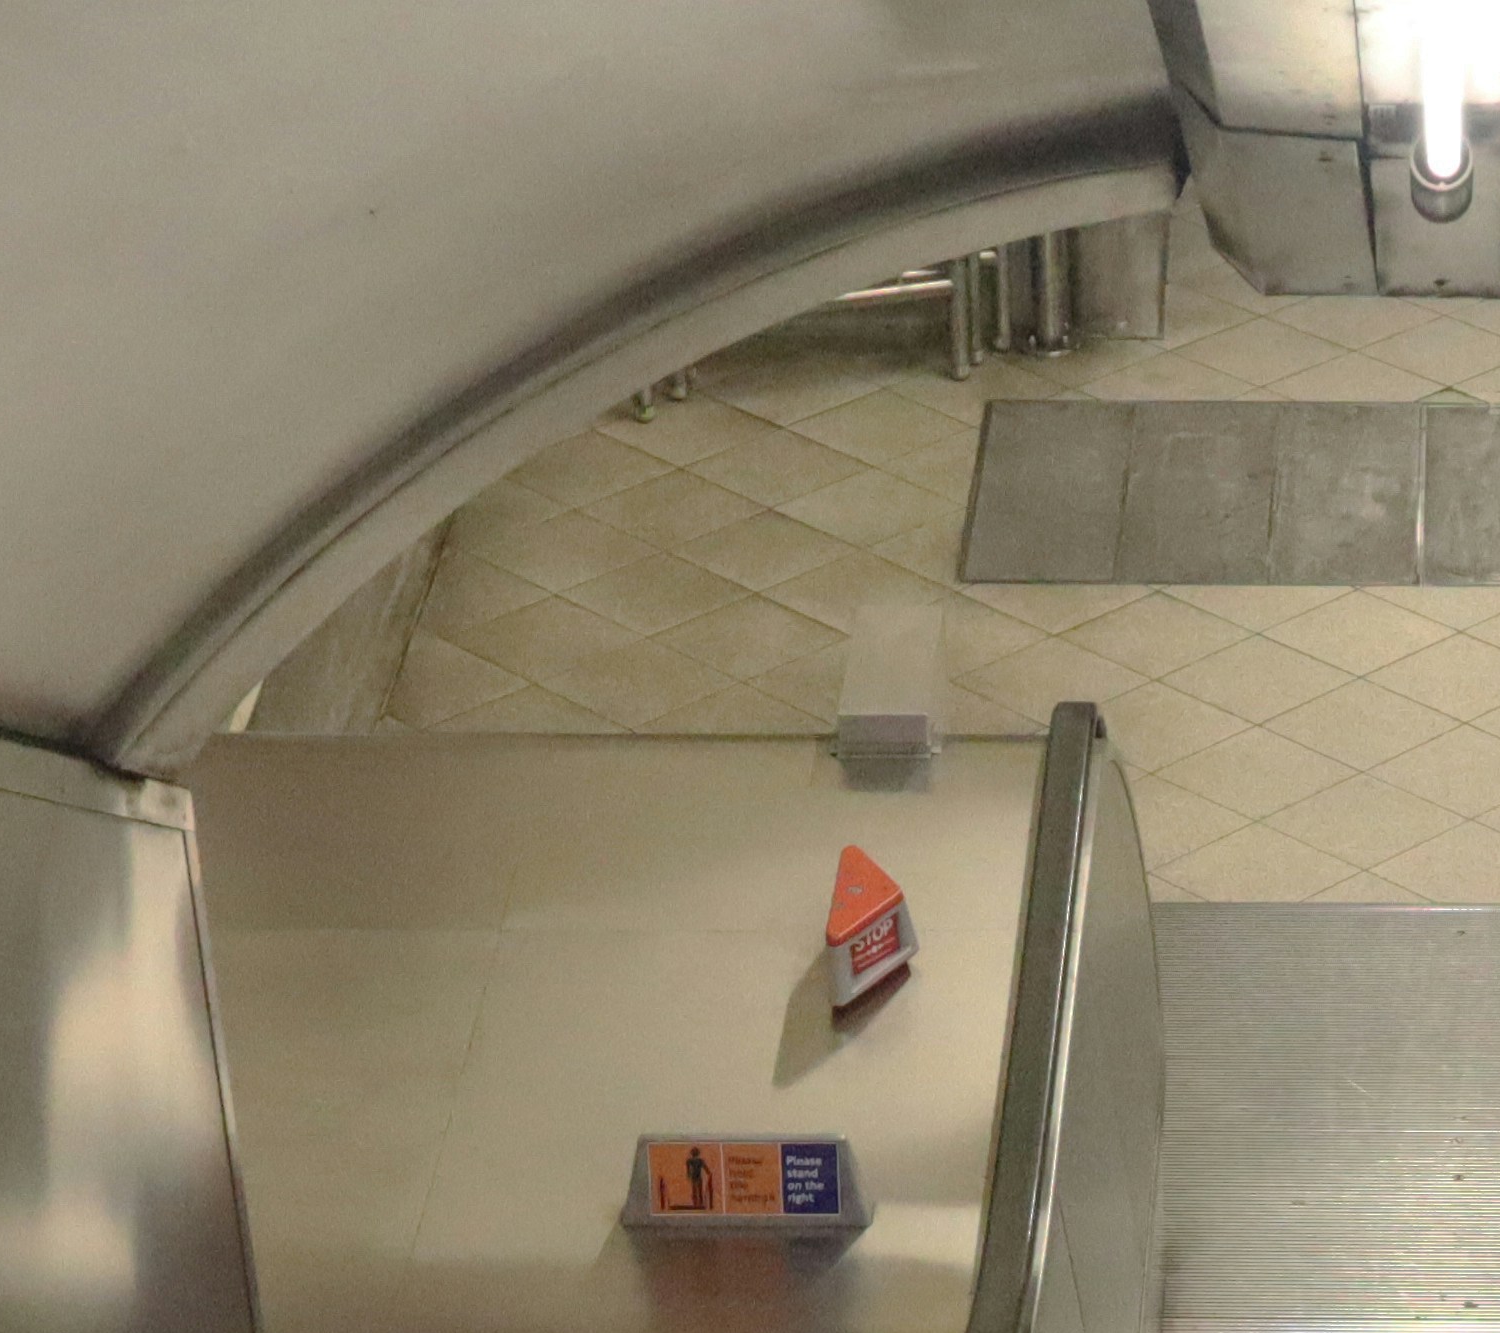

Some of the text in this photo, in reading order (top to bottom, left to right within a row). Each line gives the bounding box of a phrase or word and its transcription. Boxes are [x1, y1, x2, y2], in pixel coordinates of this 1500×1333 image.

[854, 917, 894, 952] STOP
[786, 1155, 823, 1167] Please
[787, 1168, 819, 1179] stand
[787, 1180, 825, 1191] on the
[787, 1192, 815, 1205] right
